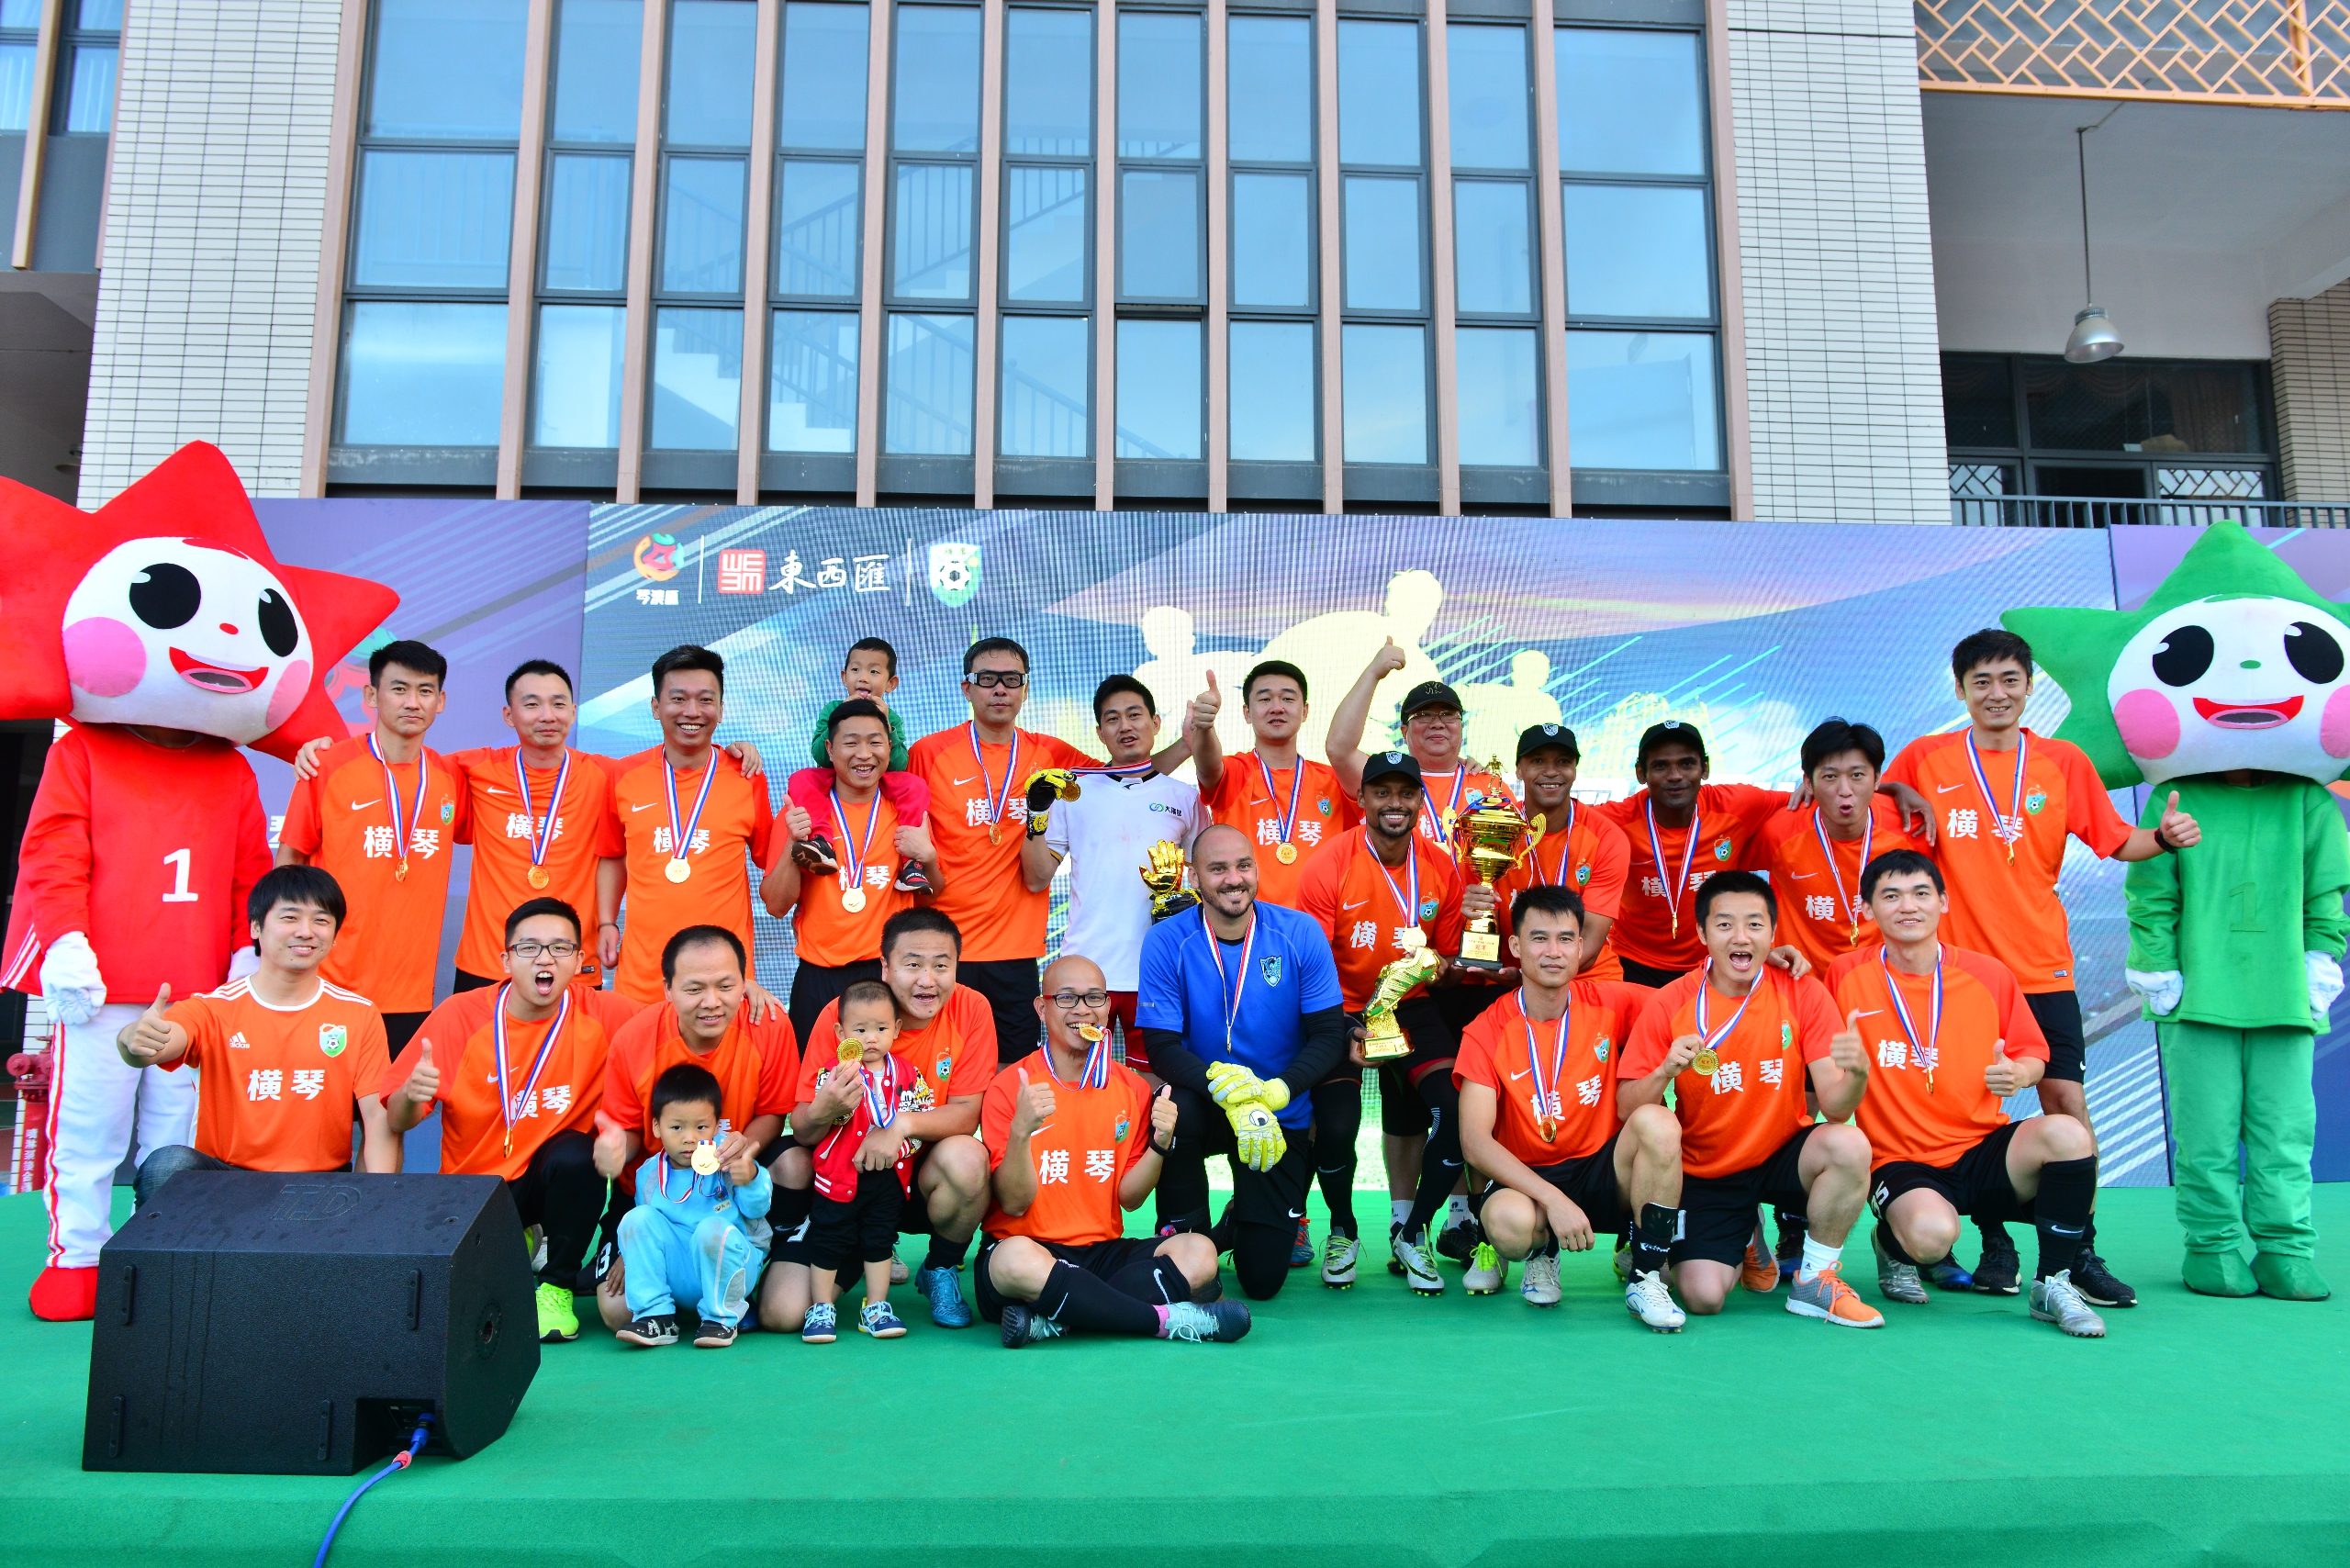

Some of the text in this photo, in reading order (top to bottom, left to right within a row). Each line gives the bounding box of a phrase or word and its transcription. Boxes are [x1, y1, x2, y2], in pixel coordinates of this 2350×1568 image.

[506, 812, 564, 842] 横琴
[966, 798, 1028, 827] 横琴
[1947, 808, 2024, 844] 横琴
[364, 825, 440, 859] 横琴
[654, 826, 711, 855] 横琴
[1256, 817, 1323, 847] 横琴
[162, 848, 198, 902] 1
[229, 1040, 250, 1049] adidas
[1877, 1038, 1939, 1073] 横琴
[247, 1069, 326, 1102] 横琴
[1709, 1057, 1784, 1096] 横琴
[511, 1083, 572, 1121] 横琴
[1529, 1073, 1603, 1126] 横琴
[1038, 1148, 1115, 1185] 横琴
